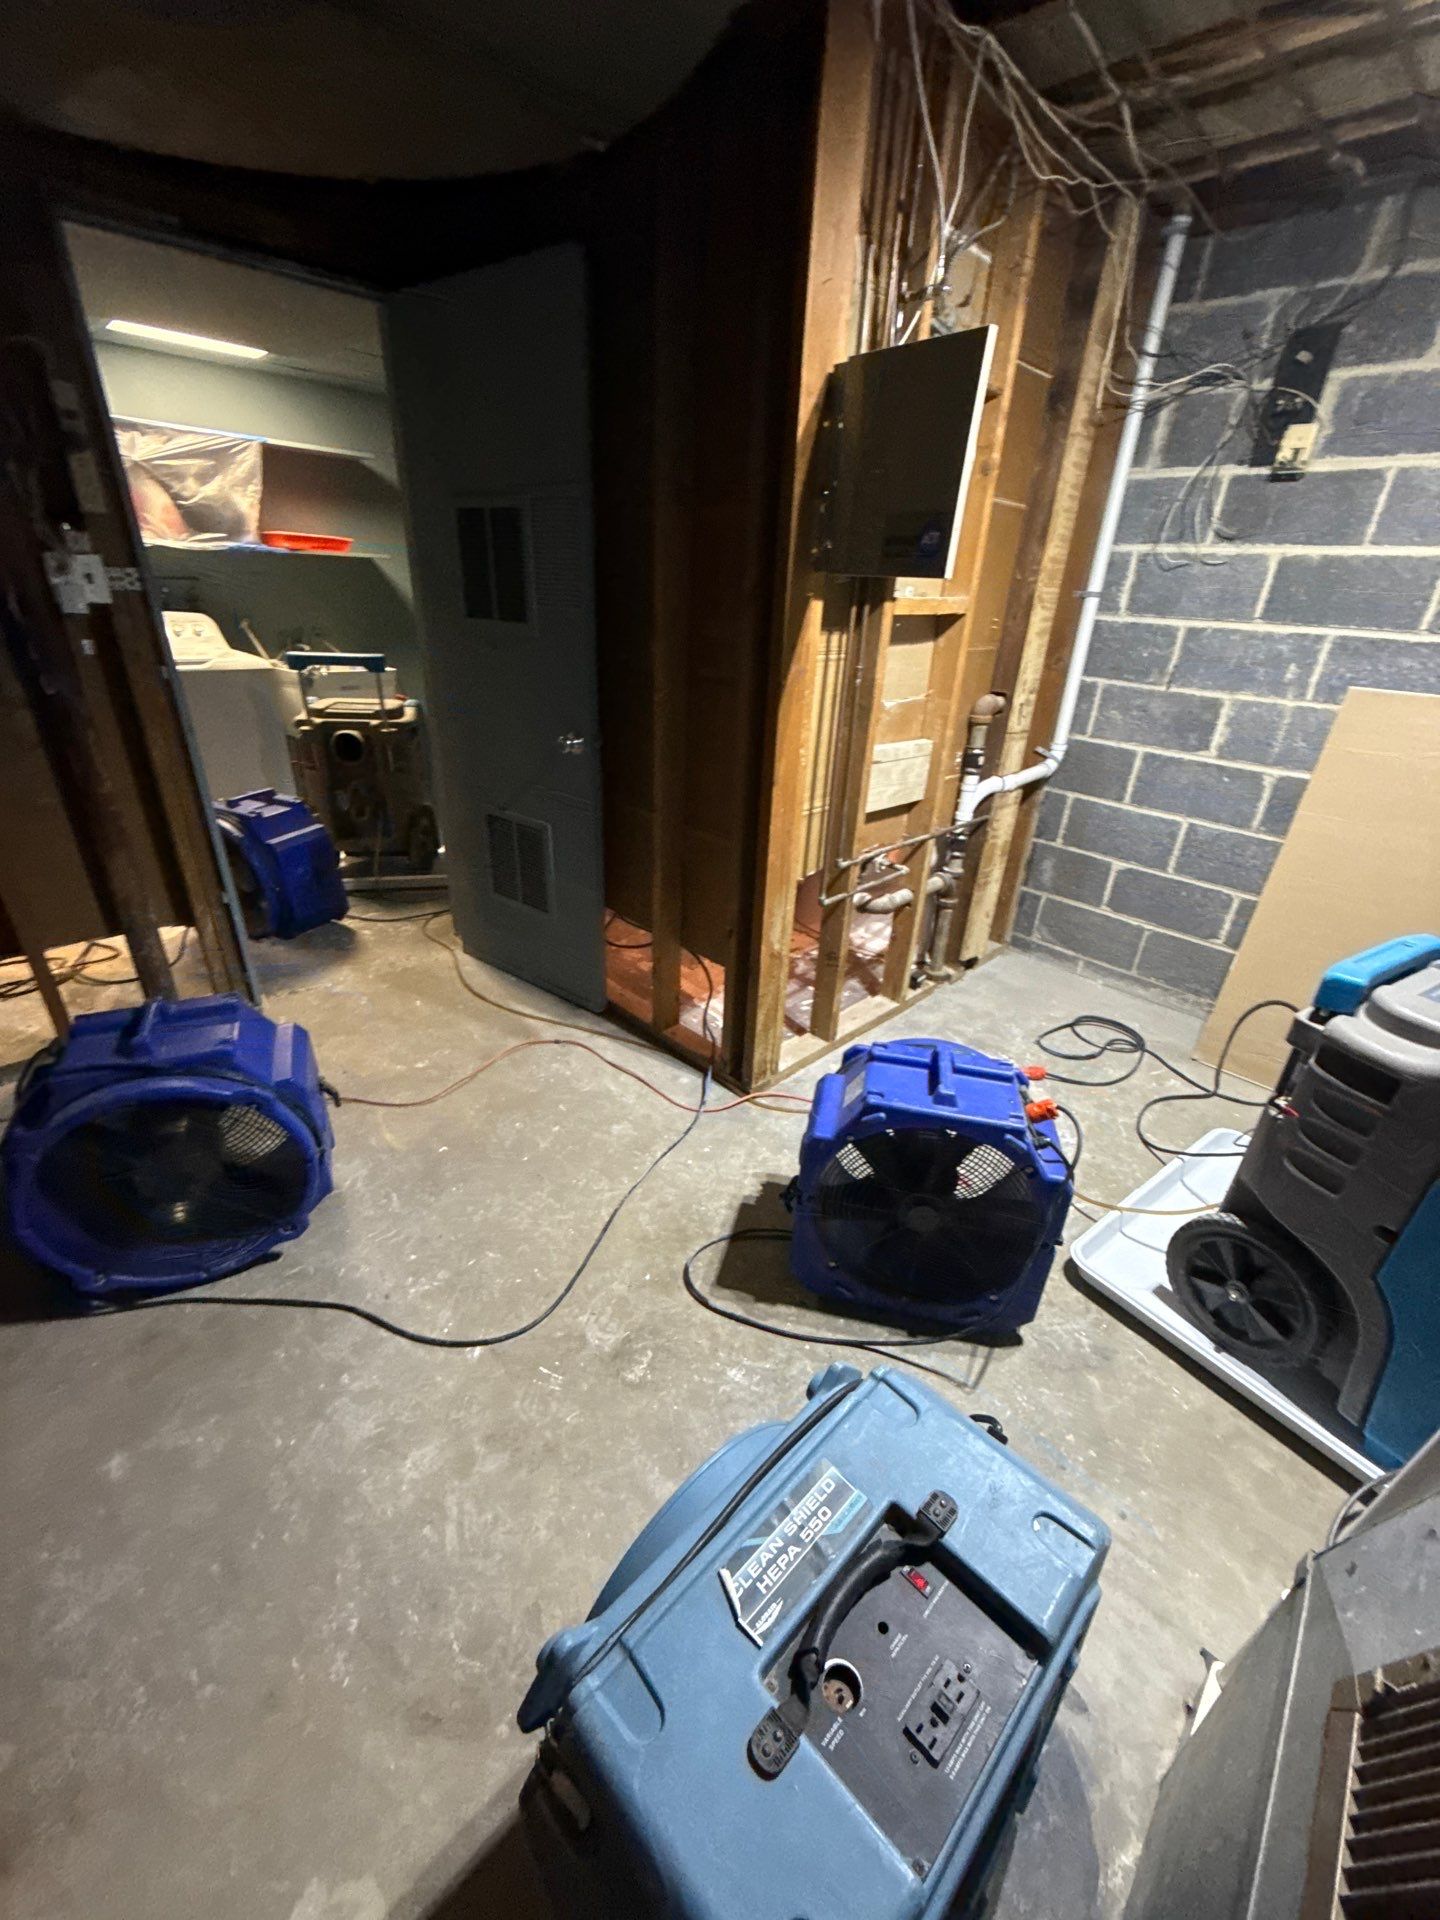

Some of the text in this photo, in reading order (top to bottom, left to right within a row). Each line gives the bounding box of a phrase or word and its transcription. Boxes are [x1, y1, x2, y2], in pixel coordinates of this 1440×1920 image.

[732, 1478, 836, 1598] CLEAN SHIELD
[756, 1506, 832, 1594] HEPA 550
[820, 1716, 843, 1747] VARIABLE
[828, 1729, 845, 1751] SPEED
